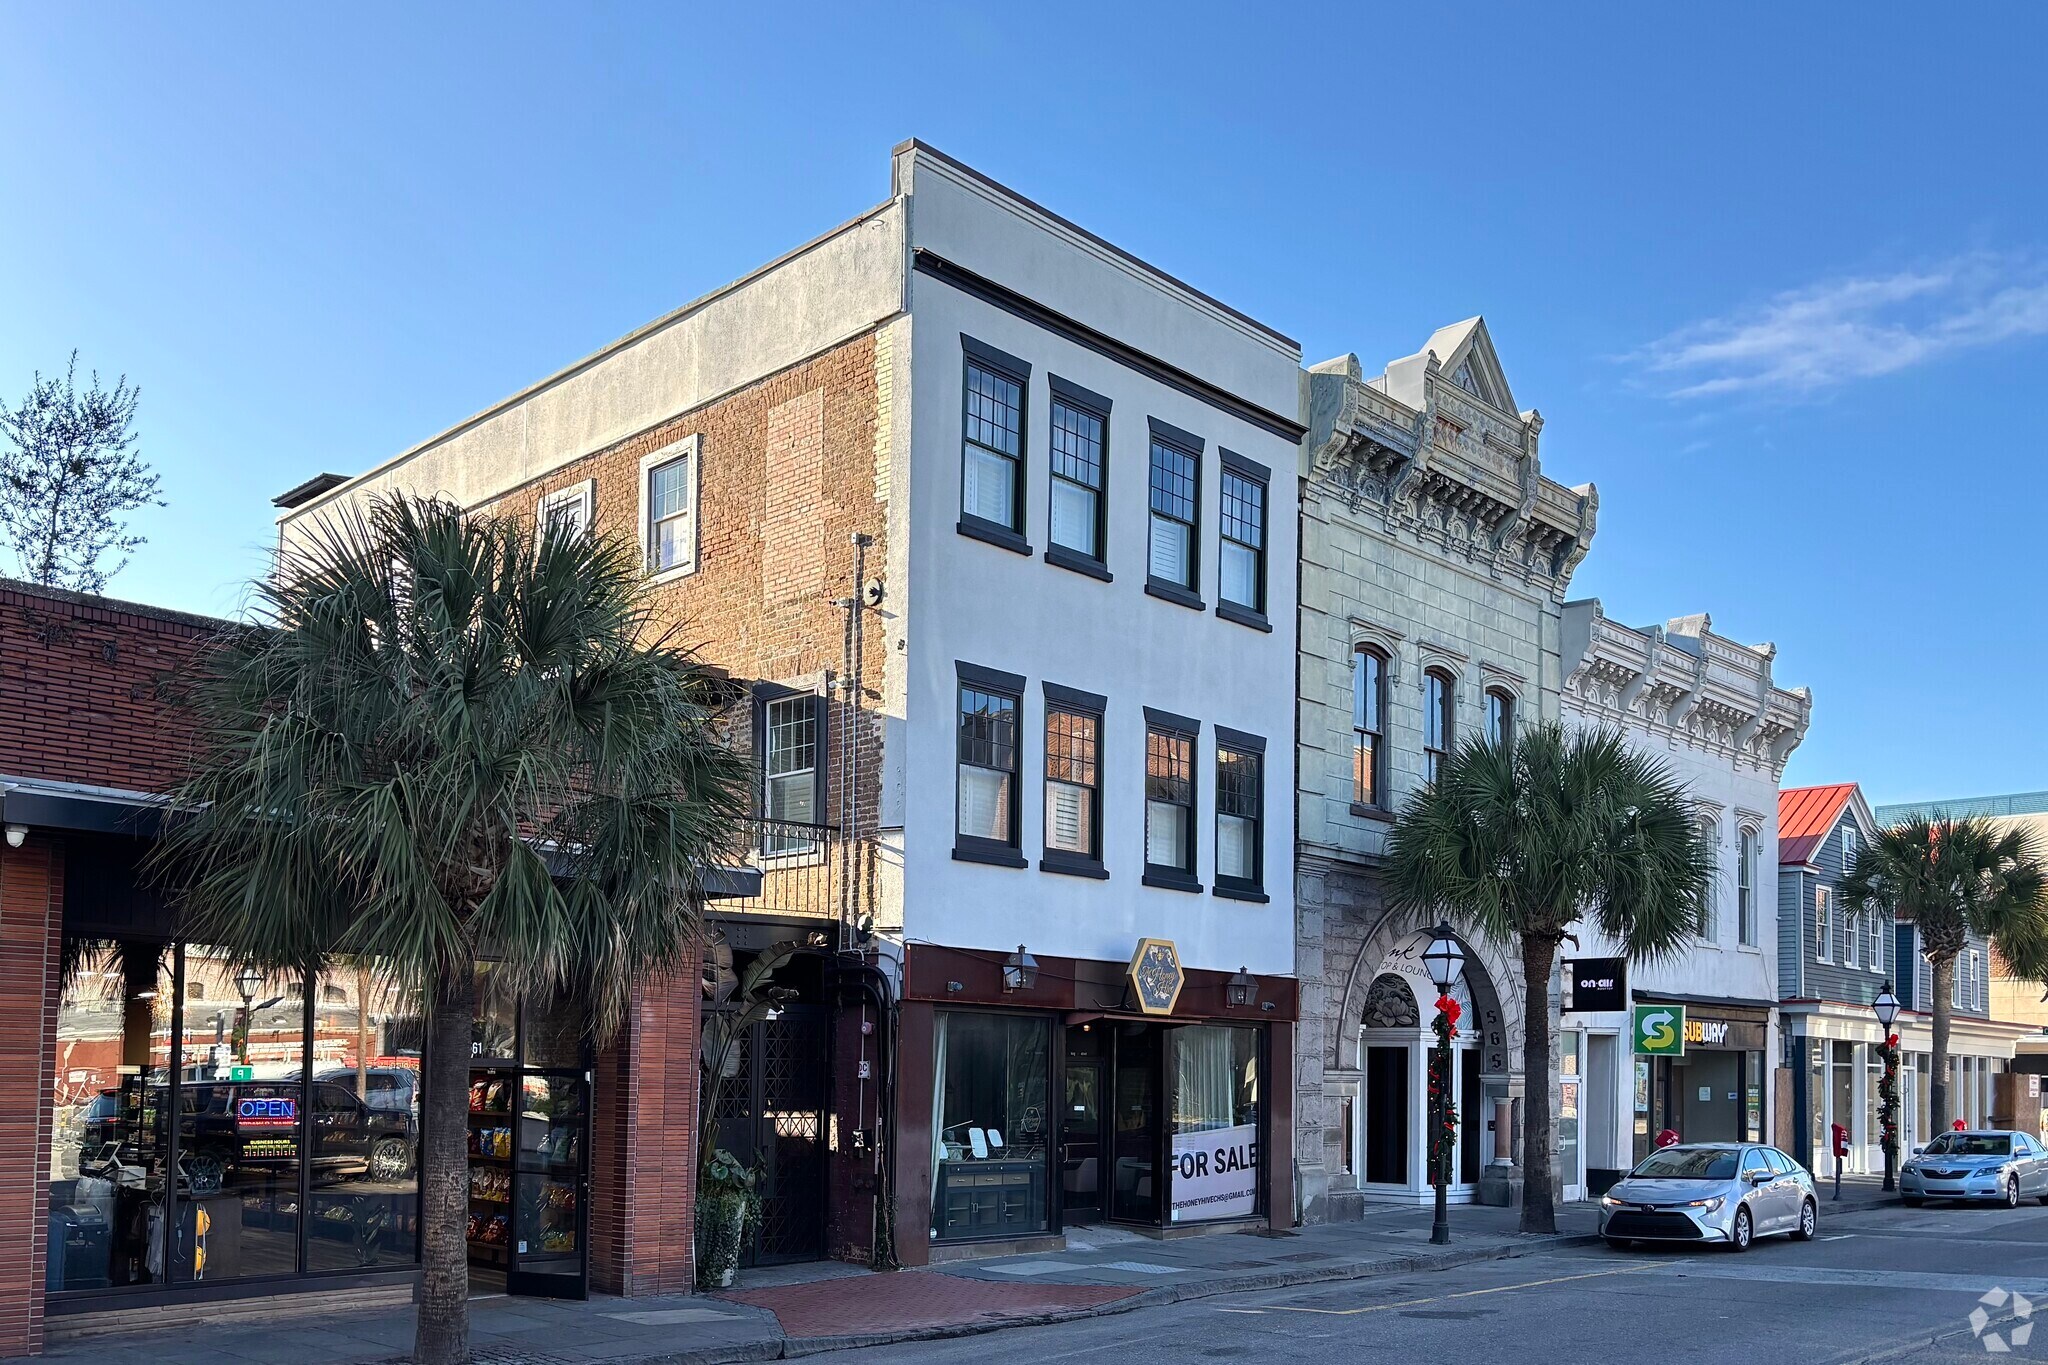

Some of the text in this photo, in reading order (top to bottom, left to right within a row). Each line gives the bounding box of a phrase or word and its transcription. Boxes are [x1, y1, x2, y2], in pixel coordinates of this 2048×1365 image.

[1684, 1020, 1729, 1044] SUBWAY
[240, 1101, 293, 1117] OPEN
[1172, 1151, 1209, 1179] FOR
[1214, 1142, 1257, 1174] SALE
